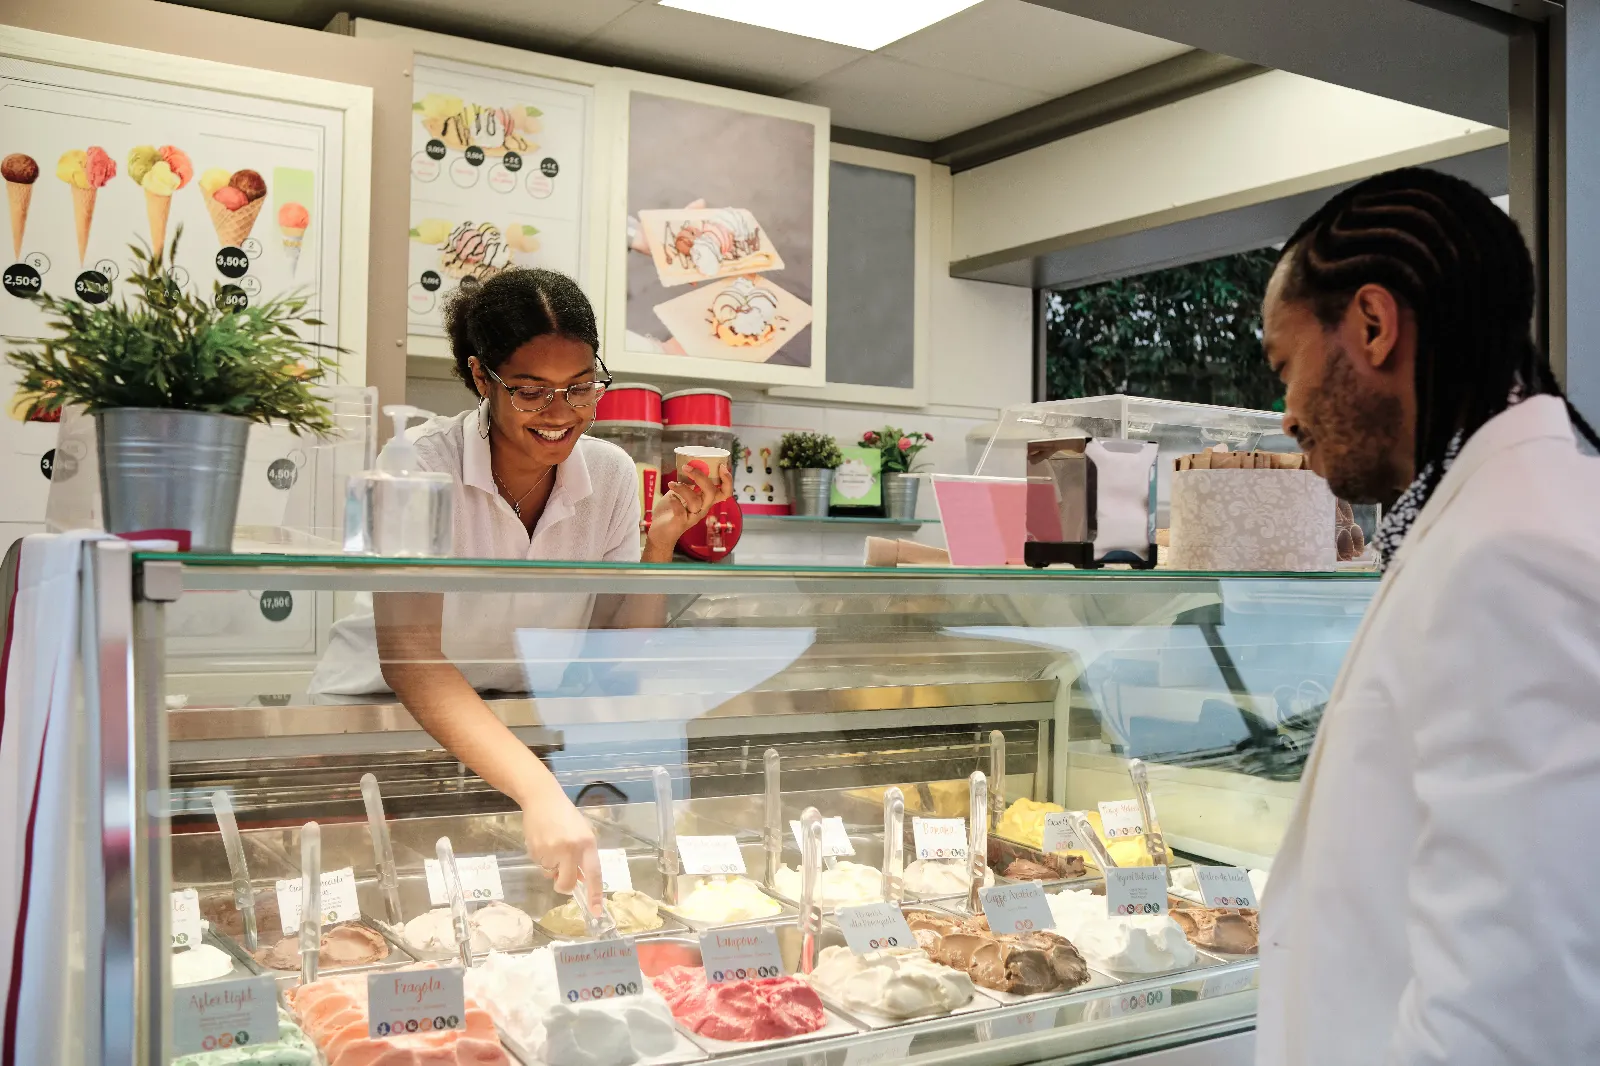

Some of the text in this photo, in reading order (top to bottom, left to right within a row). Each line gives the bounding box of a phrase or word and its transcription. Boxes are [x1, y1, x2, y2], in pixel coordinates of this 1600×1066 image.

[34, 259, 42, 268] S
[216, 254, 248, 268] 3,50€
[102, 266, 112, 274] M
[4, 274, 40, 287] 2,50€
